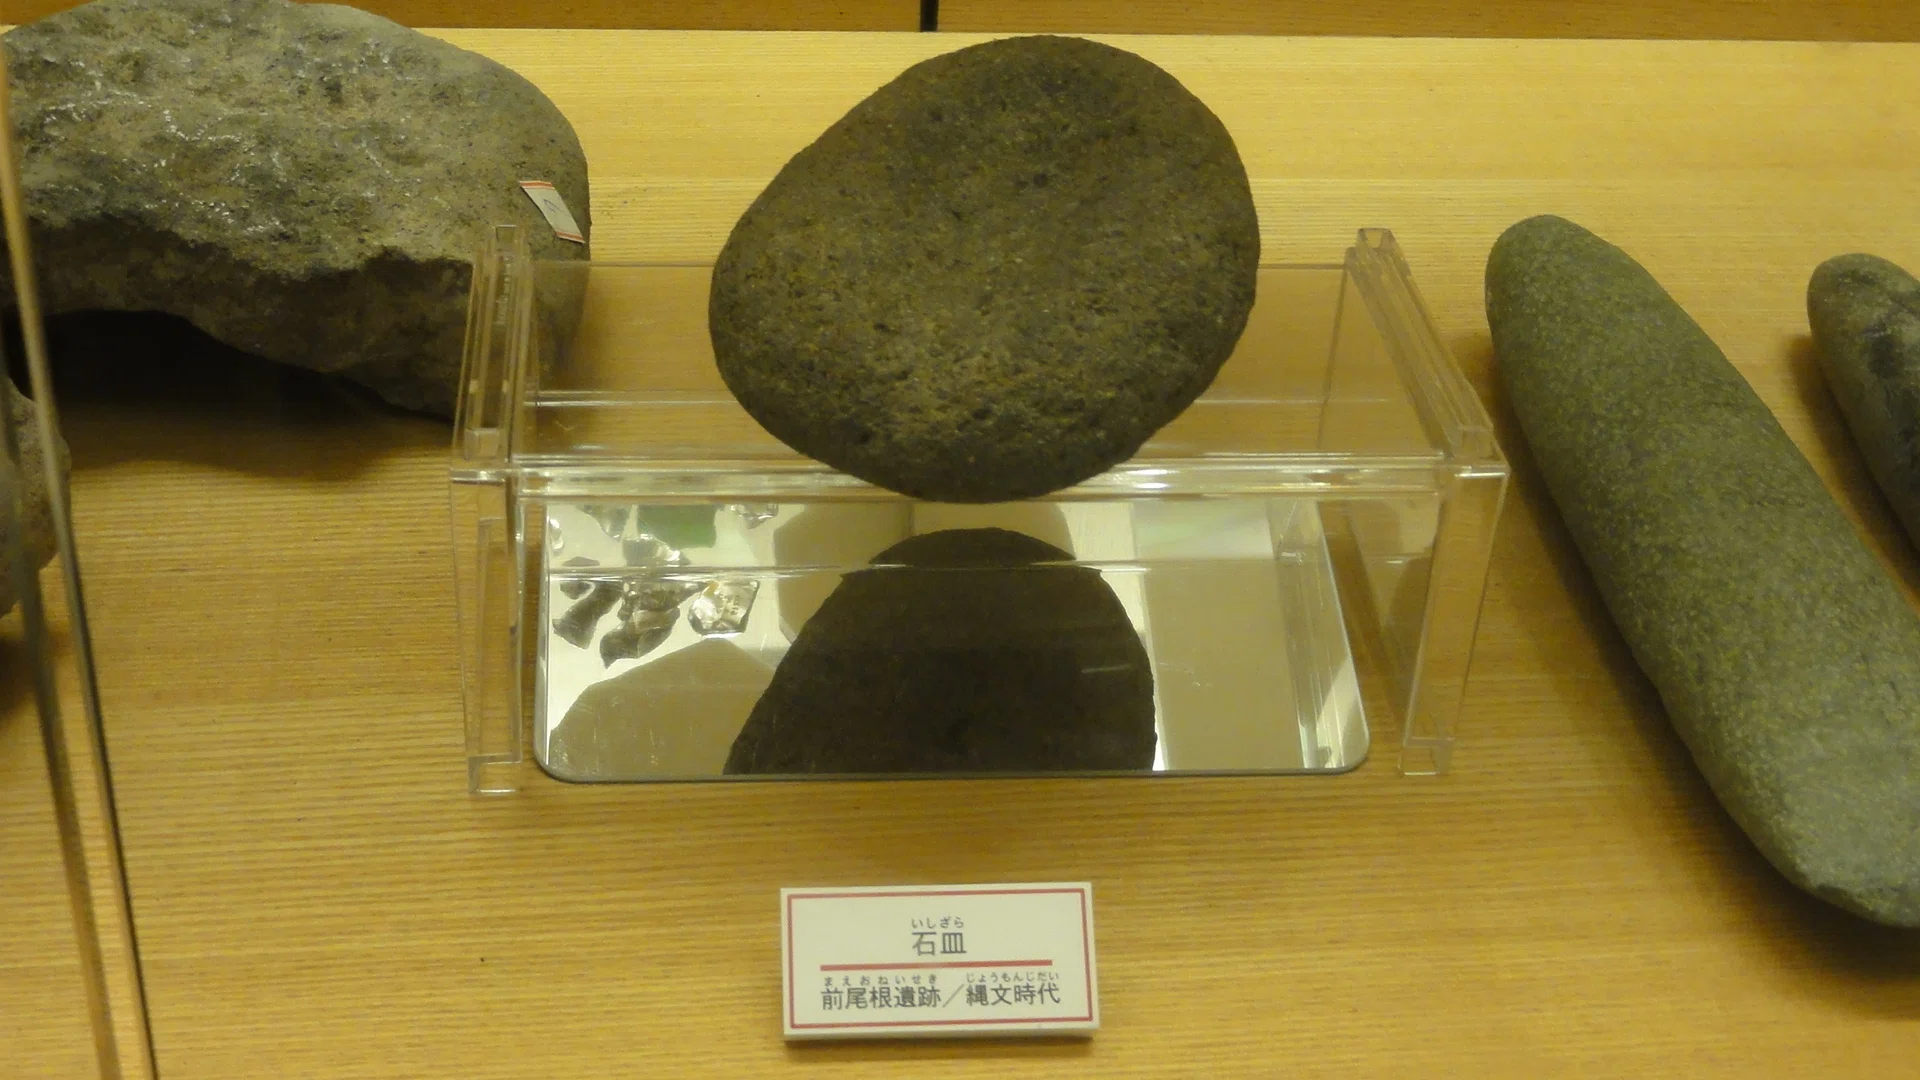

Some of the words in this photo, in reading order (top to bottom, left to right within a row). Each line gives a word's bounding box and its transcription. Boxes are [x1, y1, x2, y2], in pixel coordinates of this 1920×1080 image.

[911, 915, 964, 929] いしざら
[911, 931, 967, 956] 石皿
[824, 973, 937, 986] まえおねいせき
[966, 971, 1060, 984] じょうもんじだい
